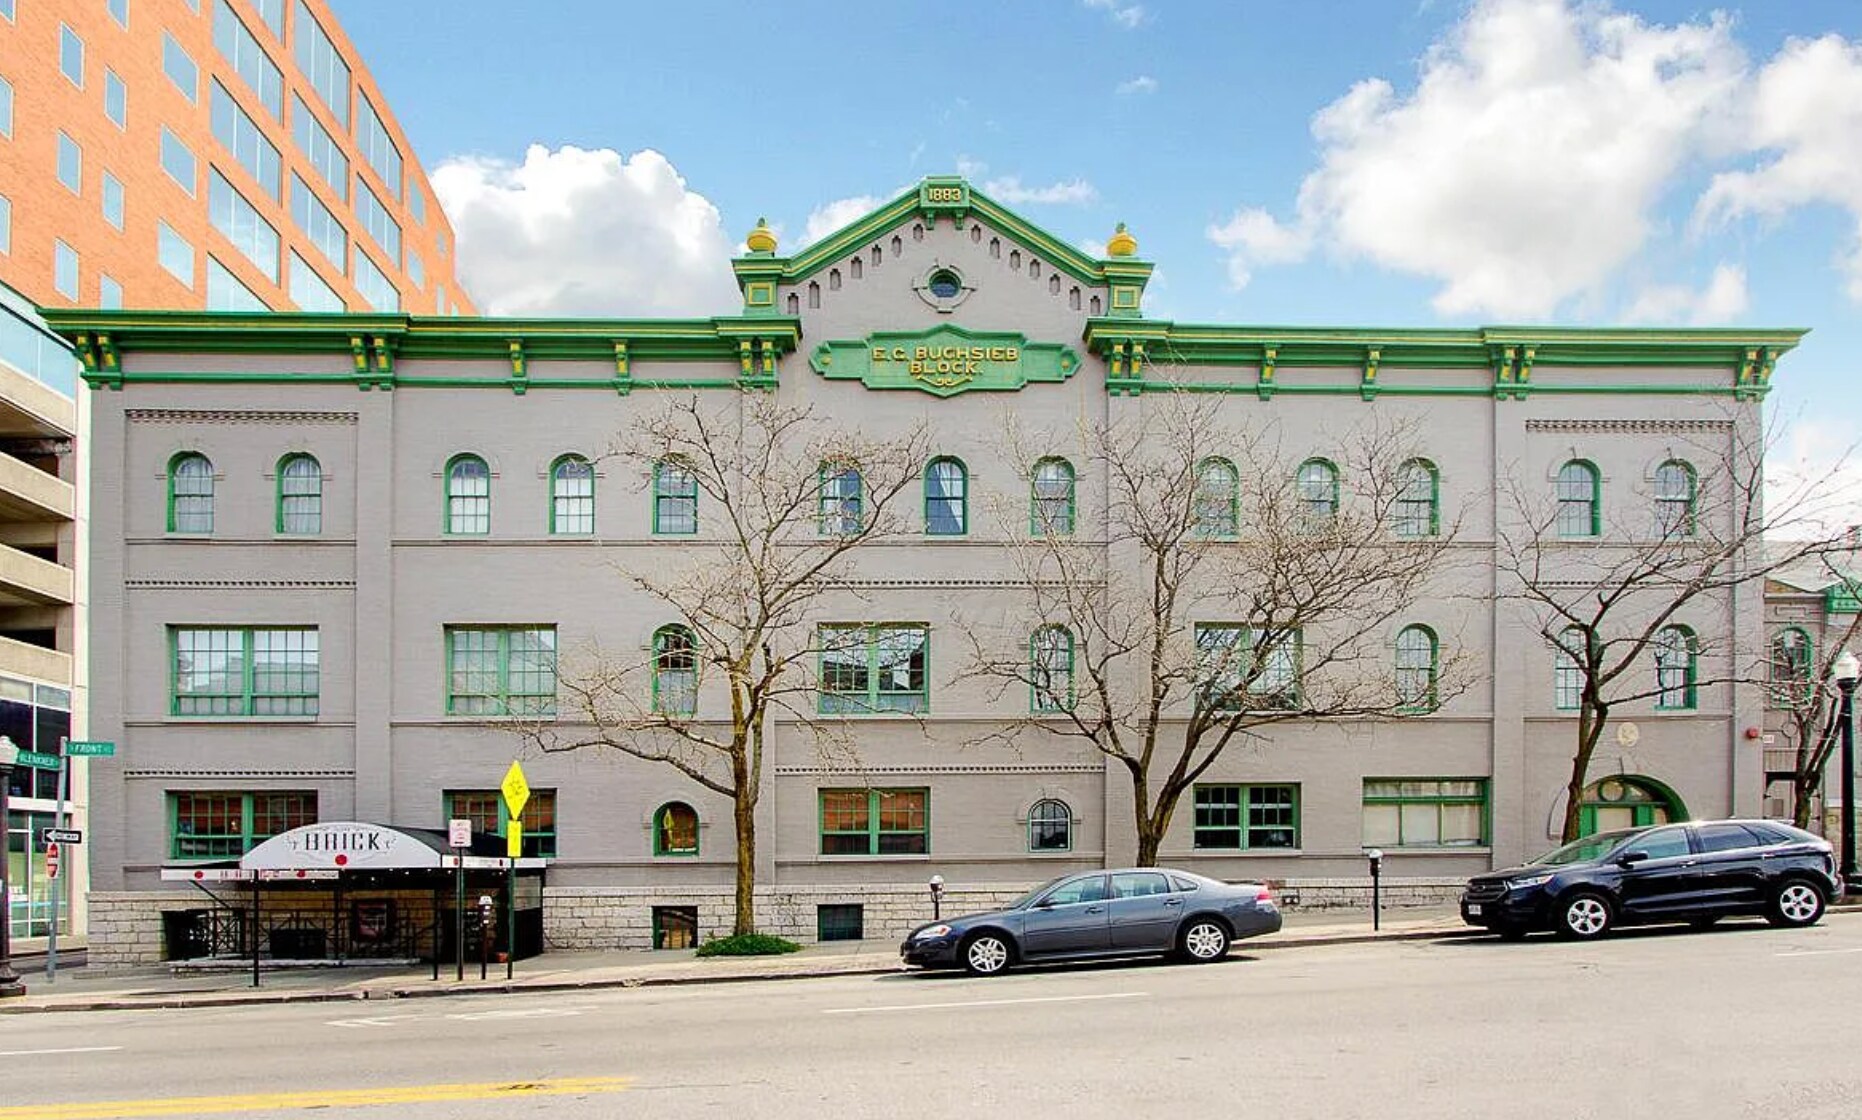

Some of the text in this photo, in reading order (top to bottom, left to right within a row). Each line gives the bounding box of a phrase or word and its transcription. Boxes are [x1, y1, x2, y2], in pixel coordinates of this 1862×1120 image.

[927, 187, 962, 202] 1883
[915, 346, 1018, 361] BUCHSIEB
[75, 743, 102, 753] FRONT
[305, 832, 379, 850] BRICK
